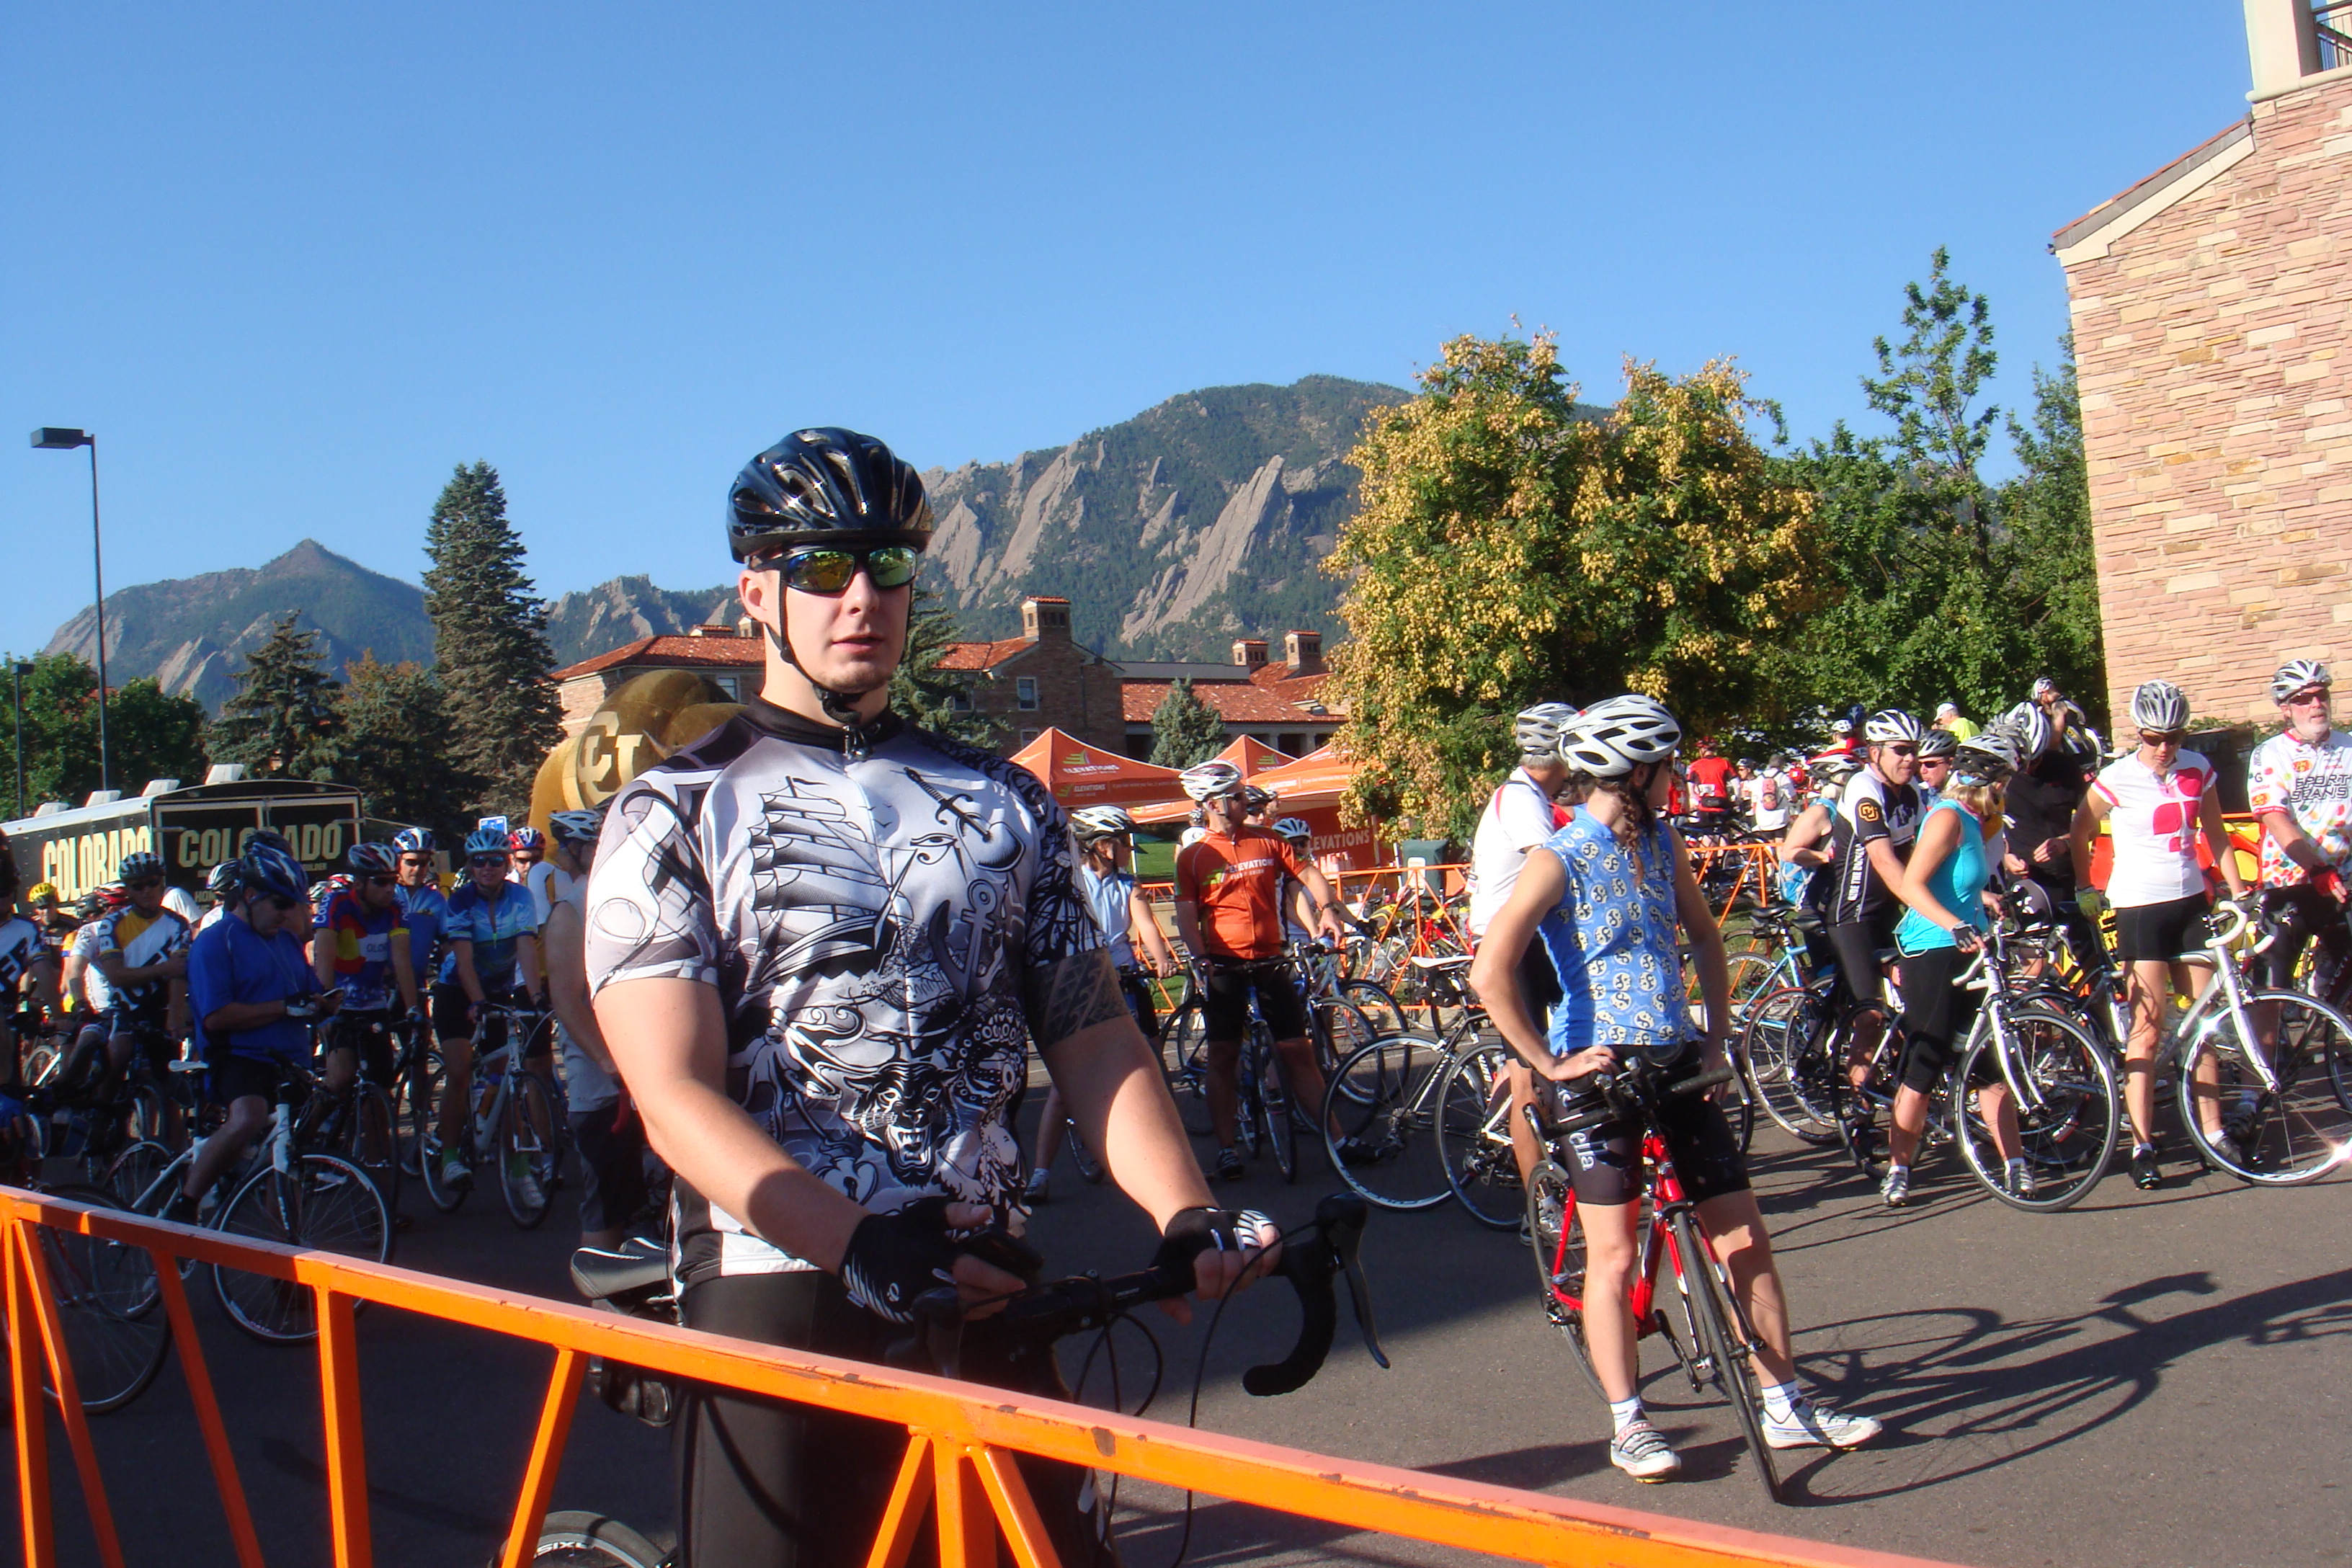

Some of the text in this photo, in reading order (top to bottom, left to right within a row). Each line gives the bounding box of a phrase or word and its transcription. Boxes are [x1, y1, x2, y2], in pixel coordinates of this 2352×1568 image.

[1074, 783, 1106, 793] ELEVATIONS
[178, 824, 342, 868] COLADO
[1309, 829, 1370, 851] LEVATIONS
[43, 824, 152, 902] COLORADO
